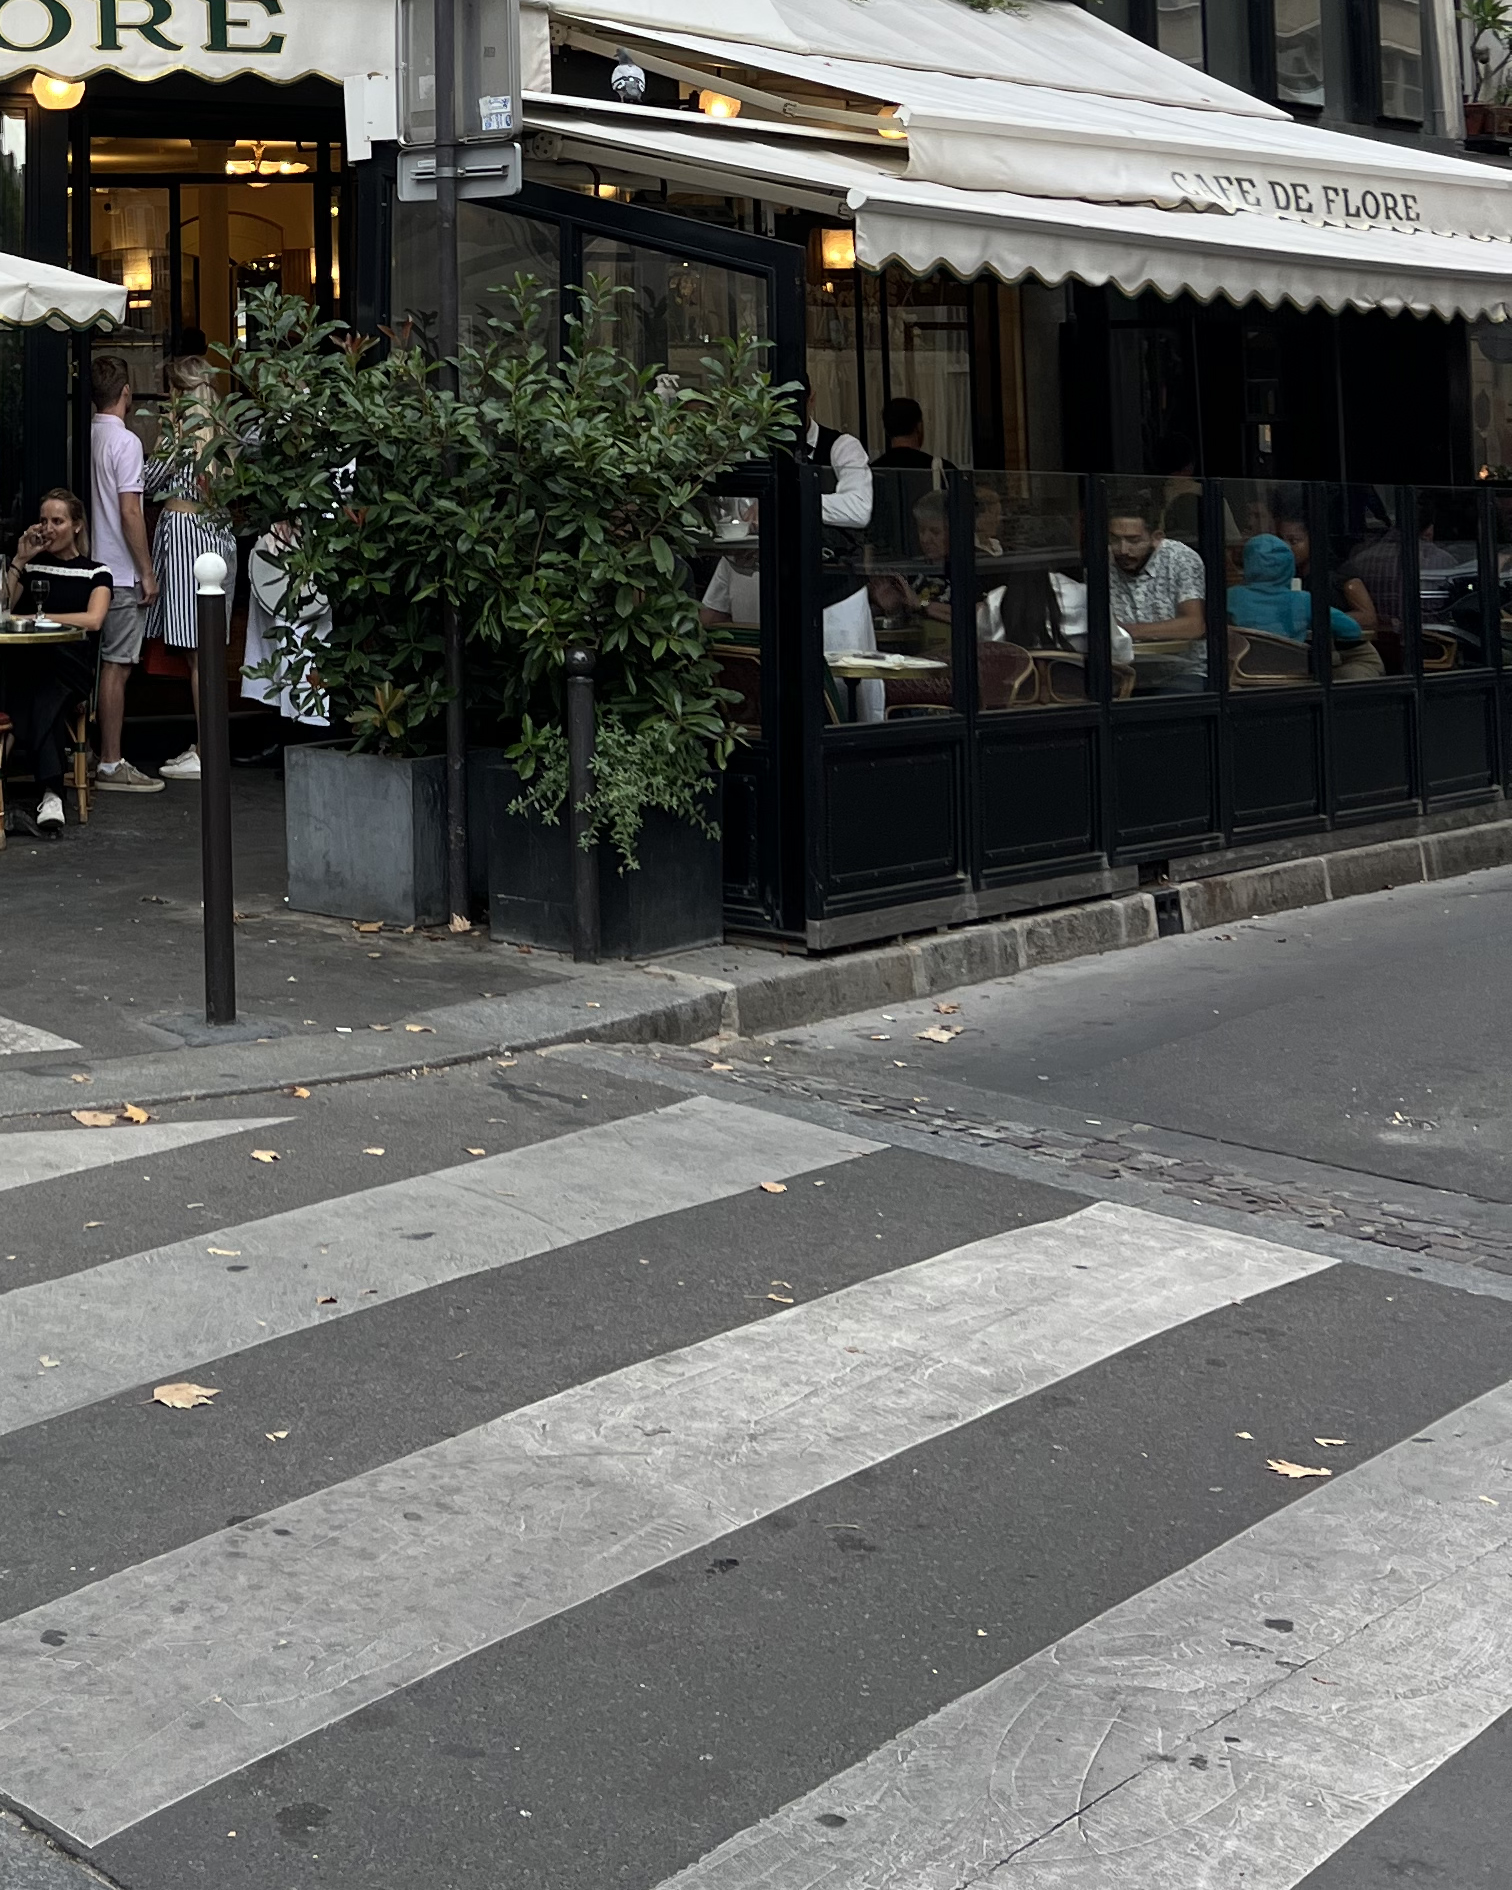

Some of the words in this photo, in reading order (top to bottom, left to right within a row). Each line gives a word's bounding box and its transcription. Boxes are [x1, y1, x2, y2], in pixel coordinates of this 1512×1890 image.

[1171, 171, 1262, 207] CAFE
[1268, 180, 1313, 213] DE
[1322, 185, 1421, 222] FLORE
